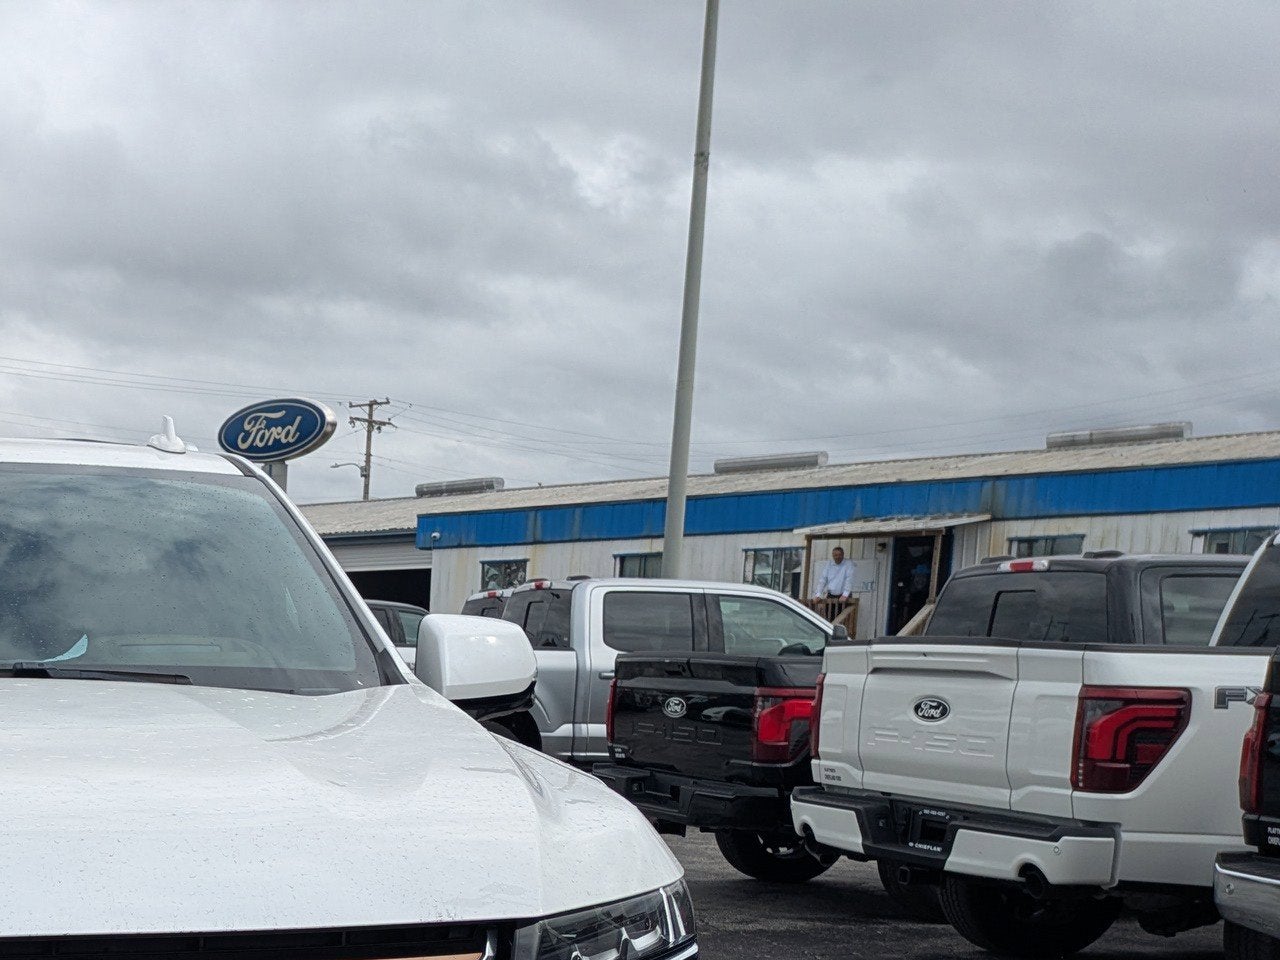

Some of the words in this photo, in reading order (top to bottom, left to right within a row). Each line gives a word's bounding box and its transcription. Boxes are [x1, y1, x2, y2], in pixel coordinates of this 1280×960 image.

[237, 410, 302, 450] Ford
[917, 700, 943, 718] Ford
[867, 726, 996, 757] F-150
